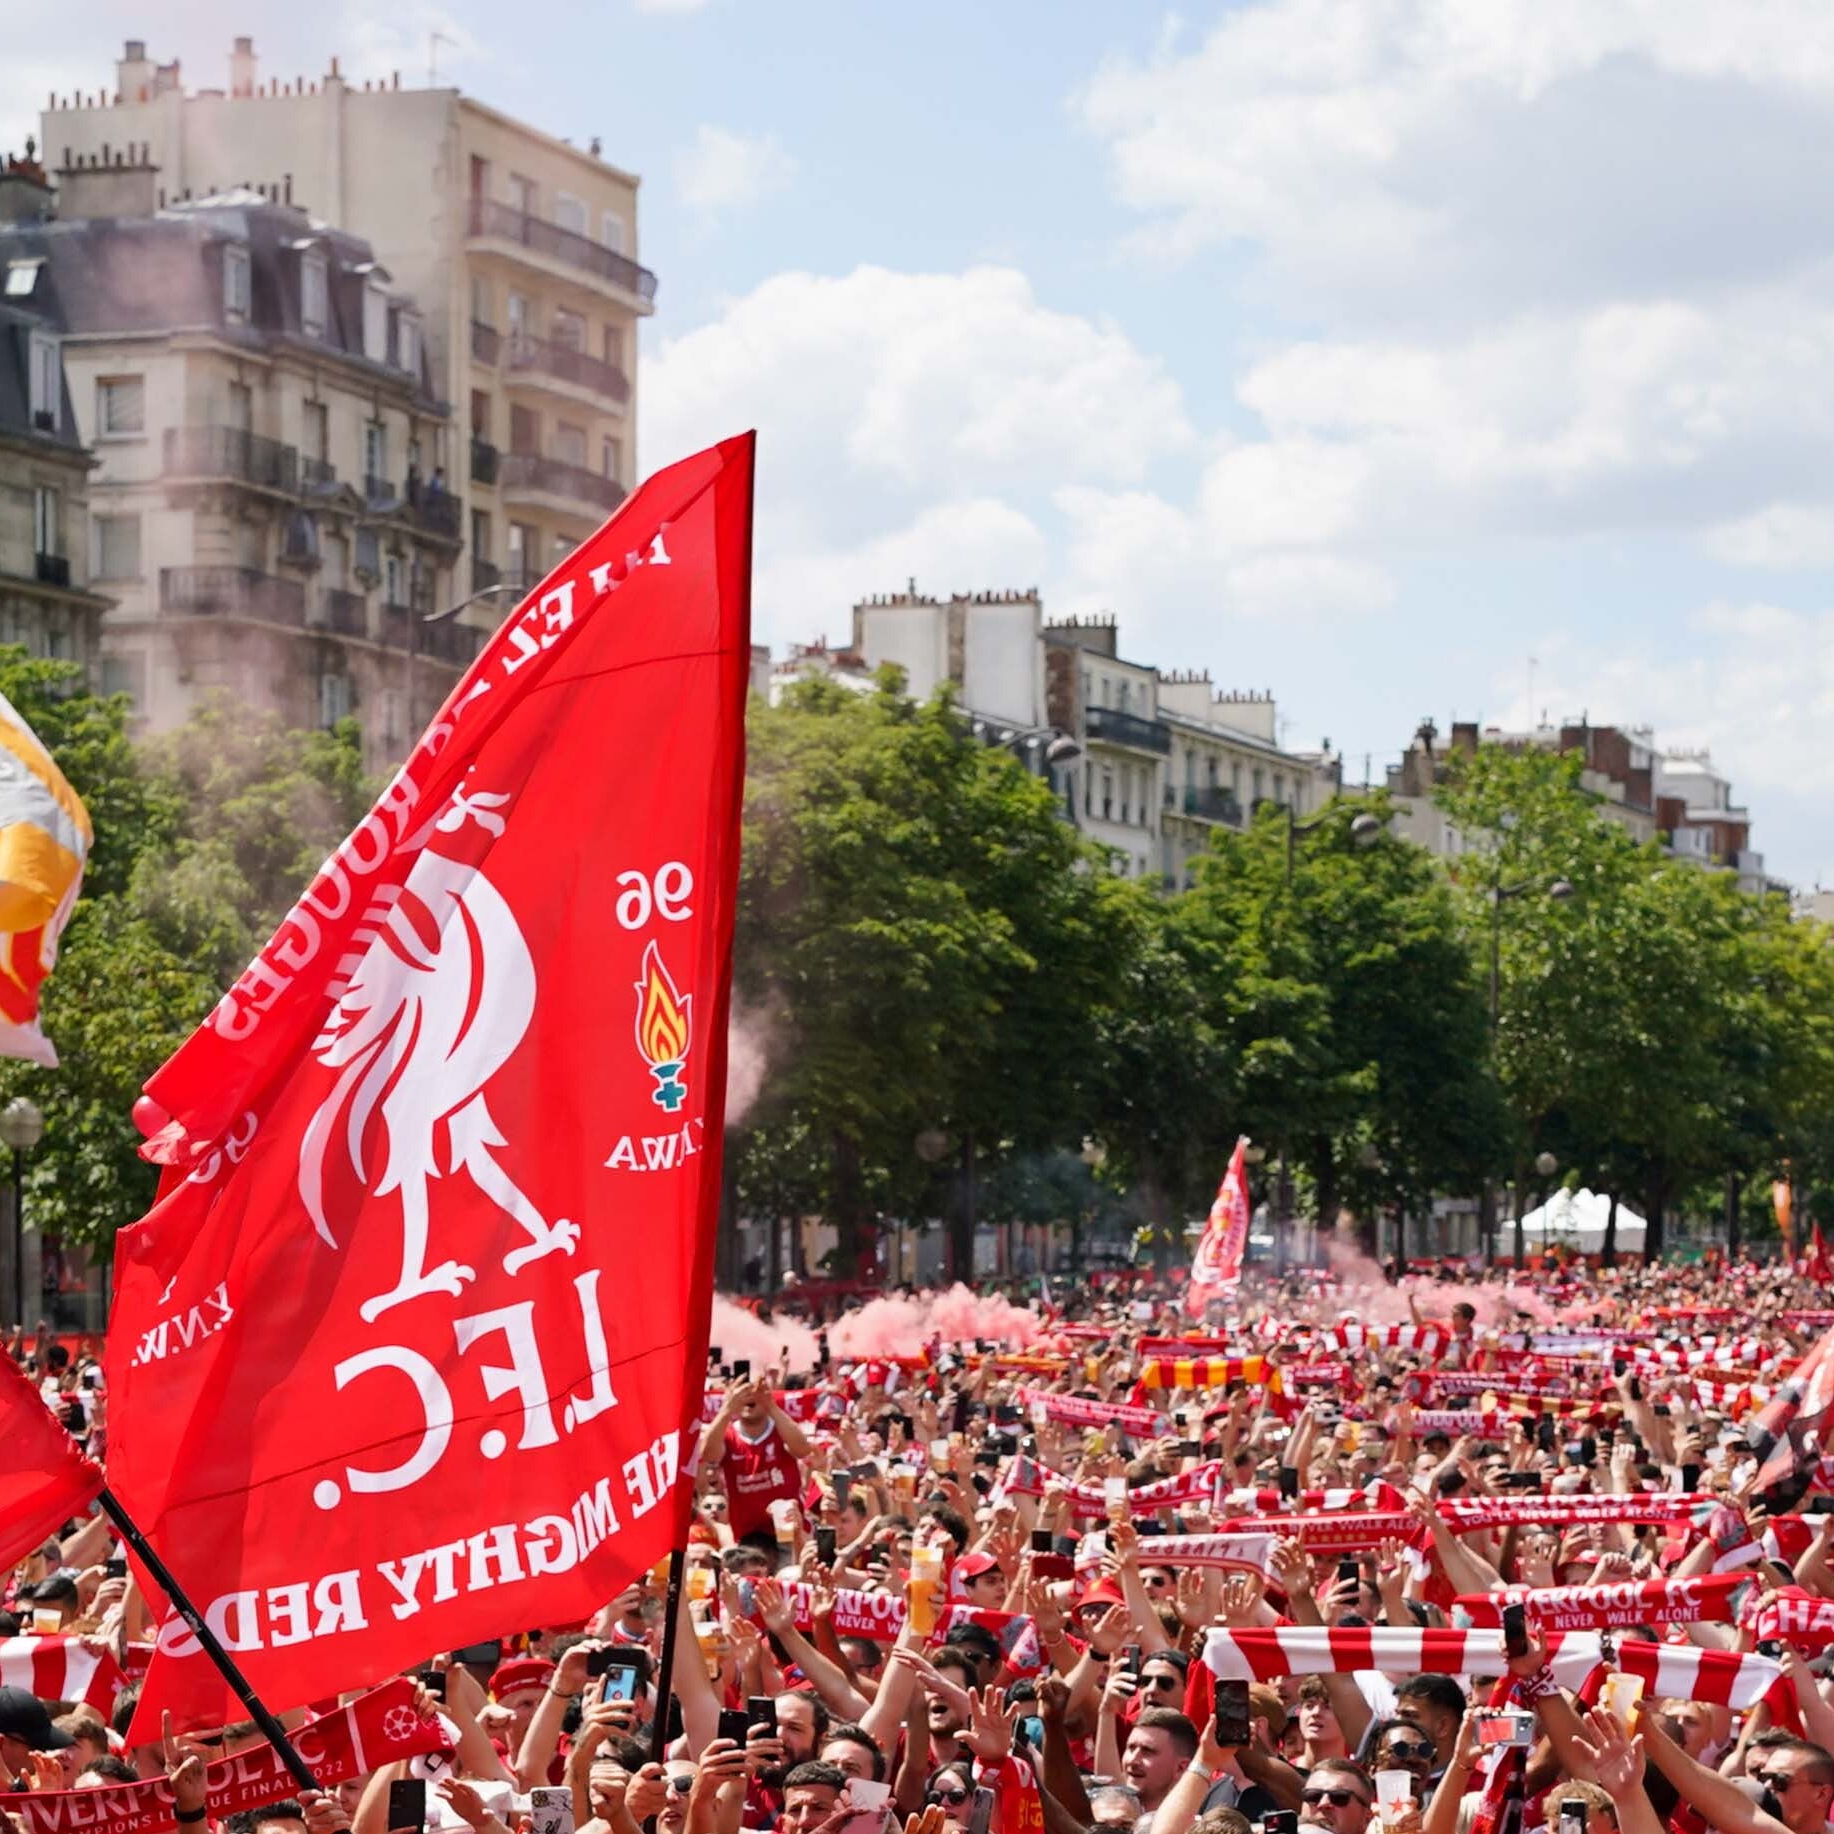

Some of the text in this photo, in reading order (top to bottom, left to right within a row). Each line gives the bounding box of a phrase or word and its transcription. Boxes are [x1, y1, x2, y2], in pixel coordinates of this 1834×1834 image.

[1517, 1507, 1569, 1522] NEVER
[1575, 1506, 1615, 1520] WALK
[1665, 1577, 1704, 1607] FC
[1555, 1606, 1702, 1629] NEVER WALK ALONE
[237, 1776, 294, 1805] FINAL
